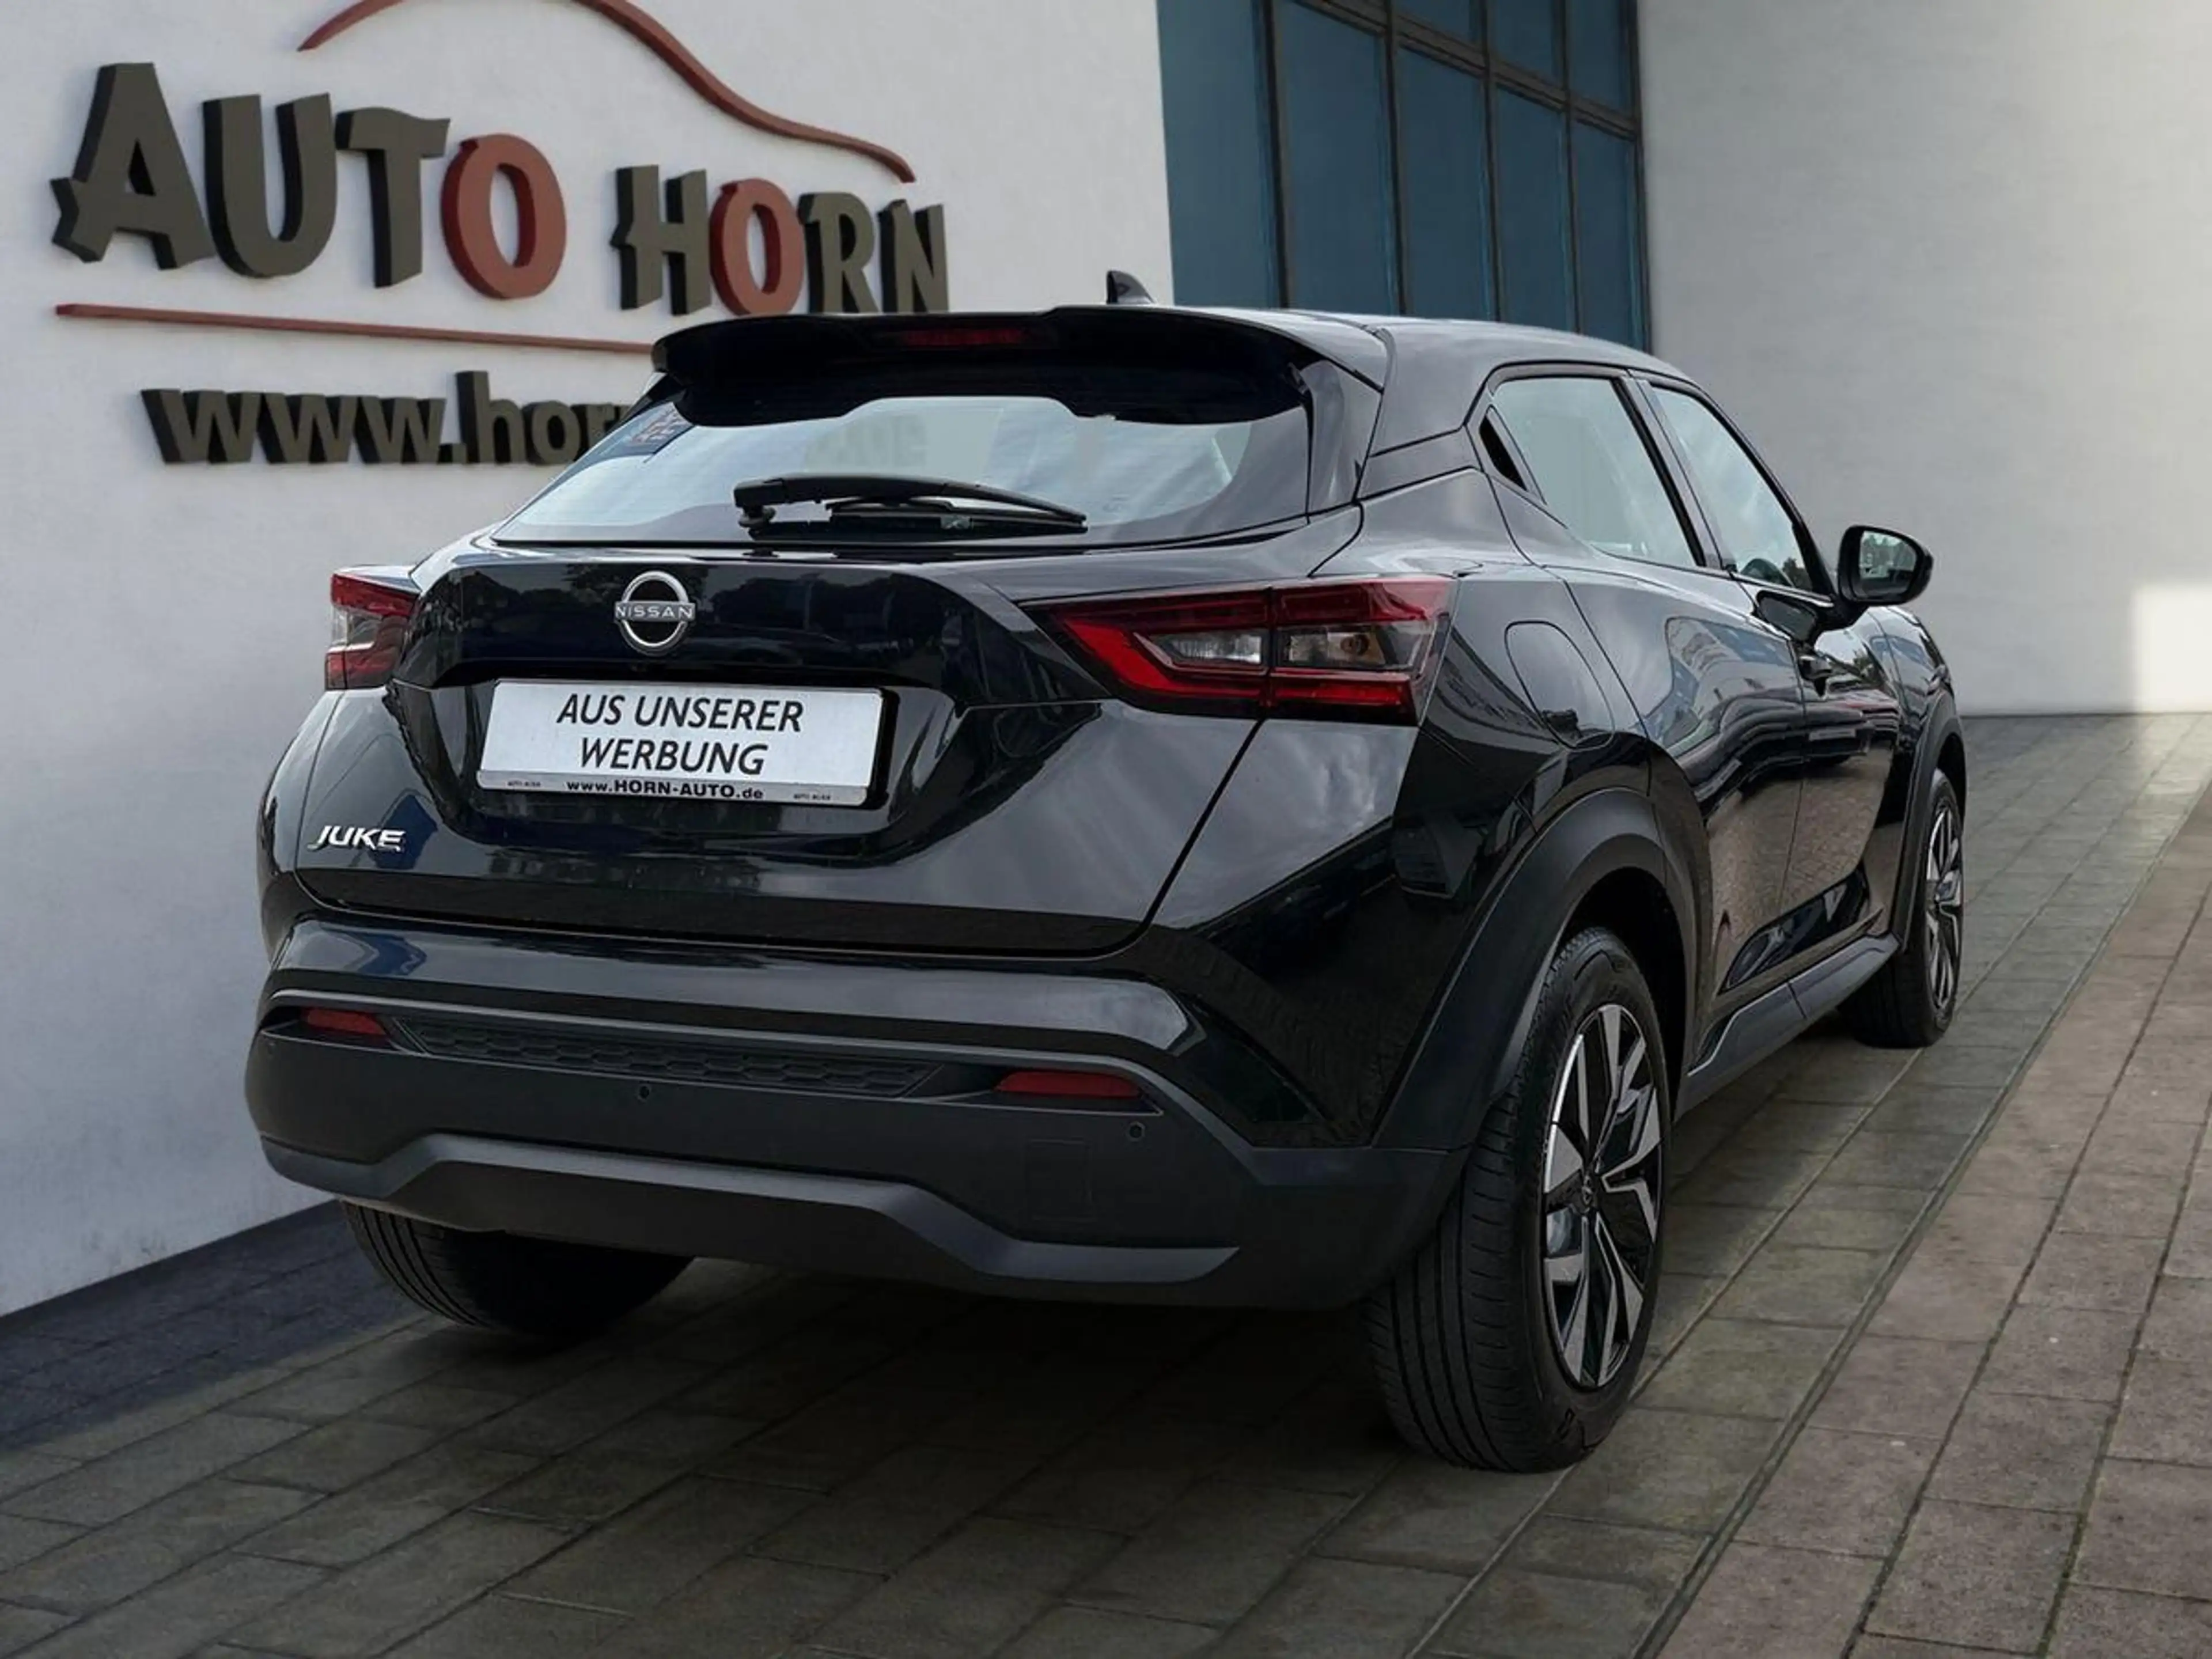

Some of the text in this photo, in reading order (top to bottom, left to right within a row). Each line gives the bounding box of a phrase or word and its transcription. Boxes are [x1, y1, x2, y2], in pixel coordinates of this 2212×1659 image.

[50, 62, 949, 316] AUTO HORN
[141, 370, 628, 465] www.hor
[615, 605, 692, 619] NISSAN
[556, 693, 804, 733] AUS UNSERER
[579, 736, 769, 776] WERBUNG
[566, 779, 764, 800] www.HORN-AUTO.de
[306, 824, 406, 853] JUKE
